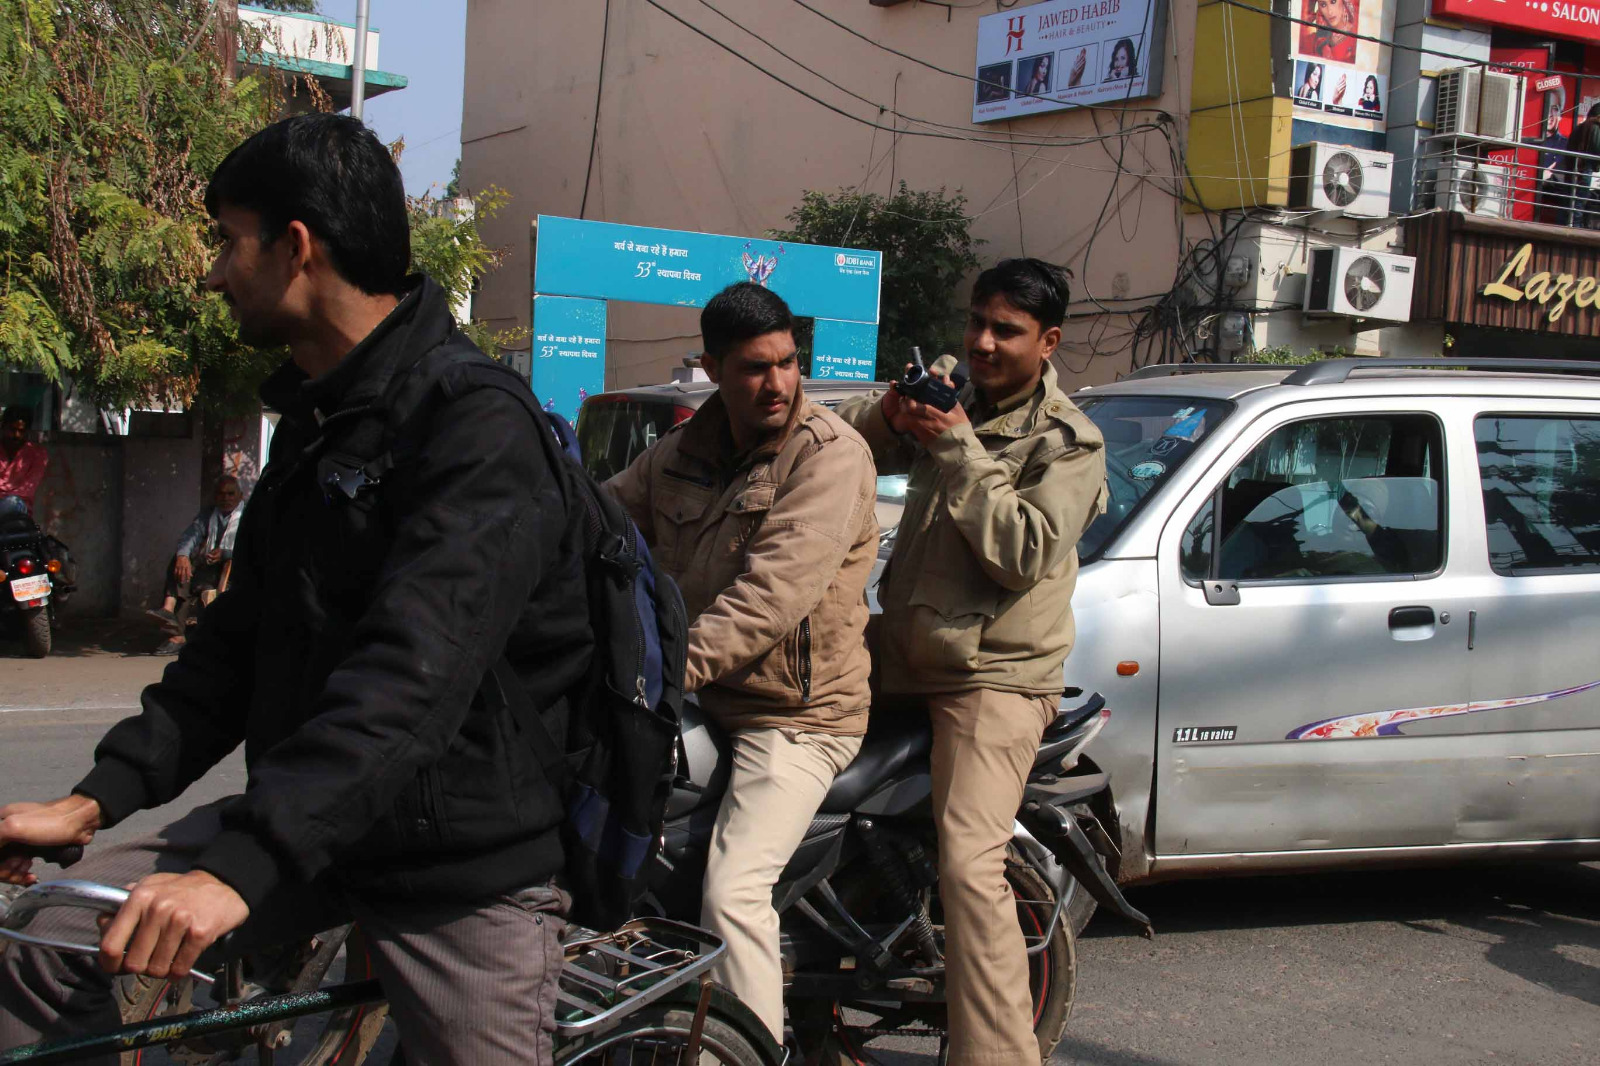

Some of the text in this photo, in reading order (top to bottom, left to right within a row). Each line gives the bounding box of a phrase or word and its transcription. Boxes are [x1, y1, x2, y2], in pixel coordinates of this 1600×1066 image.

[1038, 0, 1120, 33] JAWED HABIB
[1552, 1, 1600, 26] SALON
[1049, 28, 1067, 40] HAIR
[1076, 20, 1106, 35] BEAUTY
[1536, 77, 1561, 90] CLOSED
[627, 241, 634, 252] से
[635, 244, 649, 253] मना
[650, 244, 660, 255] रहे
[669, 247, 688, 257] हमारा
[846, 256, 860, 265] IDBI
[657, 269, 682, 279] स्थापना
[683, 269, 701, 281] दिवस
[1484, 243, 1600, 322] Laze
[1200, 731, 1209, 741] 16
[1210, 728, 1234, 740] valve
